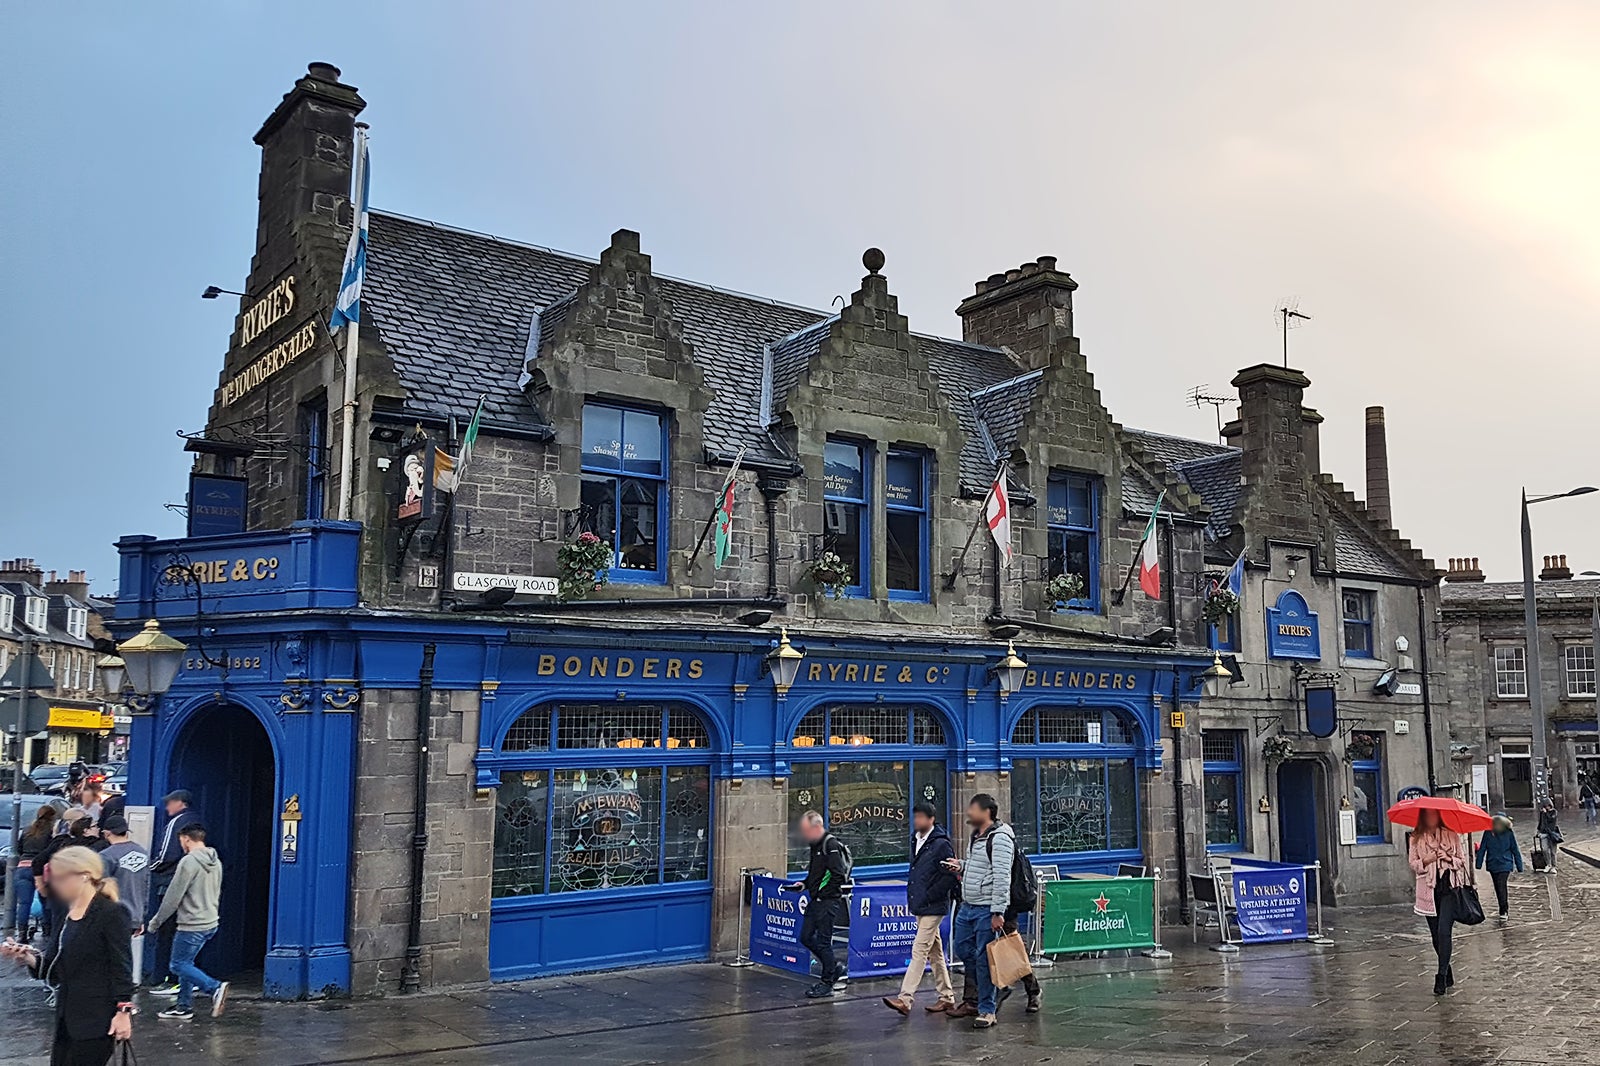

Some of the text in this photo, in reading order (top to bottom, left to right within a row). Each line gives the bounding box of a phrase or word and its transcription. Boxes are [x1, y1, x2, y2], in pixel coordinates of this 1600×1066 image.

[241, 275, 294, 347] RYRIE'S
[230, 341, 287, 404] YOUNGER'S
[287, 321, 317, 363] ALES
[592, 445, 637, 459] Shown ere
[611, 440, 635, 451] Sprts
[231, 559, 249, 581] &
[457, 575, 555, 591] GLASGOW ROAD
[1279, 624, 1312, 637] RYRIE'S
[227, 656, 261, 669] 1862
[537, 654, 704, 679] BONDERS
[808, 662, 887, 683] RYRIE
[897, 665, 913, 683] &
[1025, 670, 1136, 690] BLENDERS
[830, 805, 905, 825] BRANDIES
[566, 846, 641, 865] REAL ALE
[1253, 884, 1286, 897] RYRIE'S
[767, 897, 795, 913] RYRIE'S
[1270, 898, 1279, 907] AT
[881, 904, 915, 918] RYRI
[878, 921, 918, 932] LIVE MUS
[1074, 916, 1125, 932] Heineken
